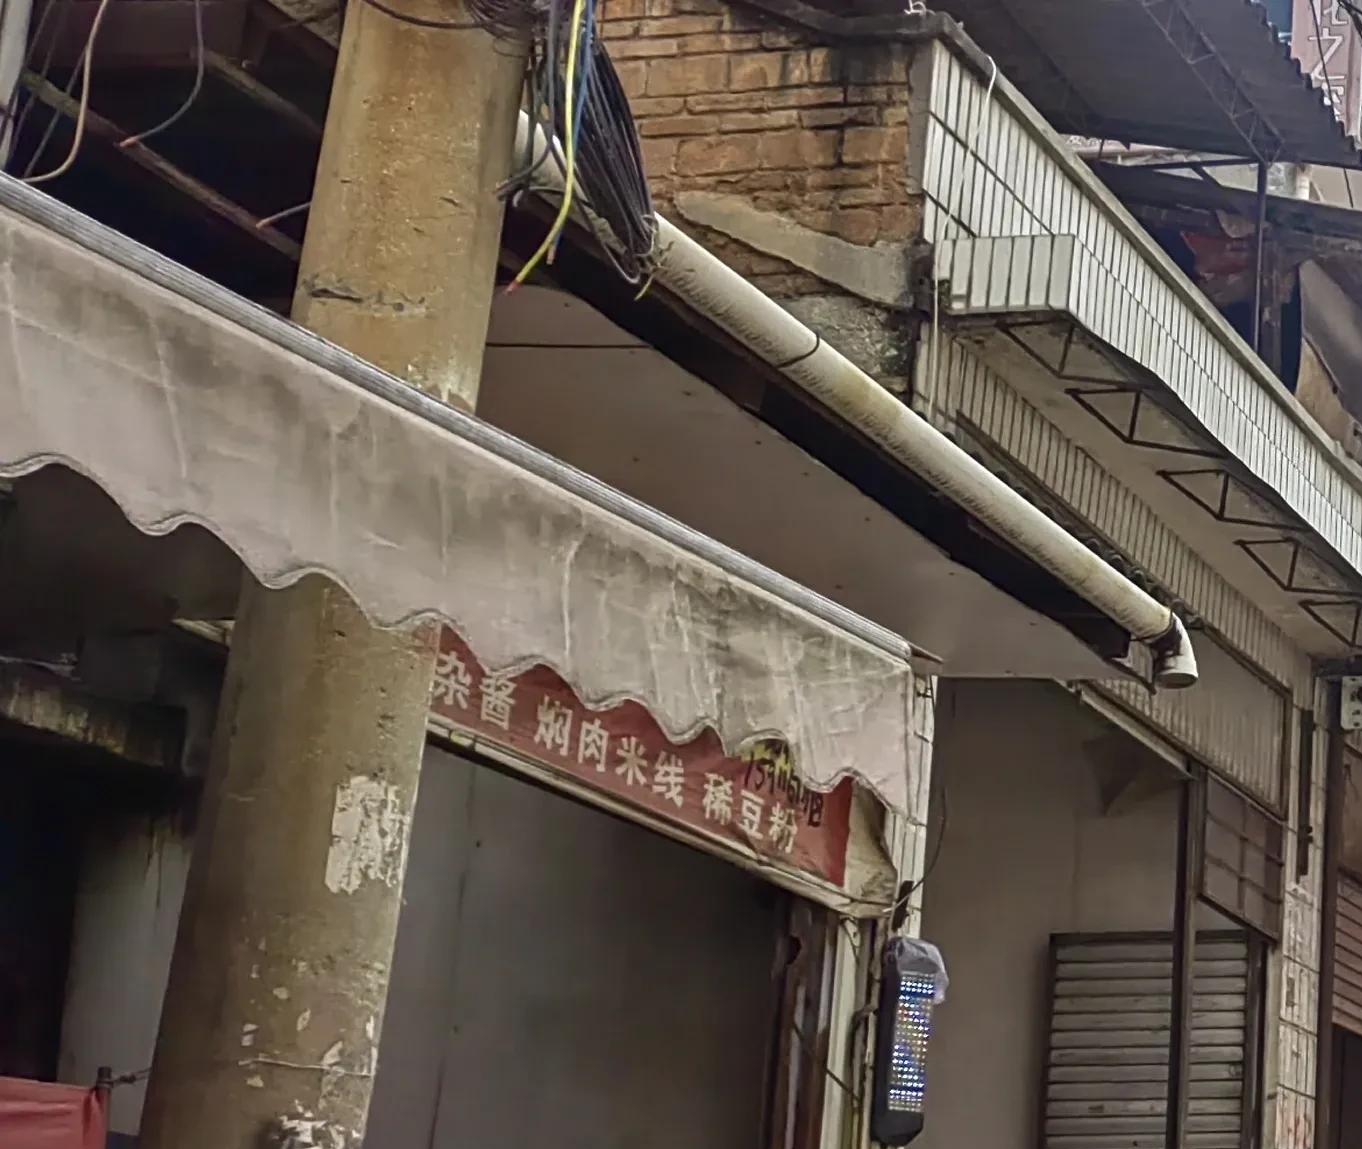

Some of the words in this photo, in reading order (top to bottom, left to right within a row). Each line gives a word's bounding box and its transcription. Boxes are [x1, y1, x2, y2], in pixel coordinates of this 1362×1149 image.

[430, 650, 517, 732] 杂酱
[533, 694, 686, 810] 焖肉米线
[701, 771, 799, 855] 稀豆粉
